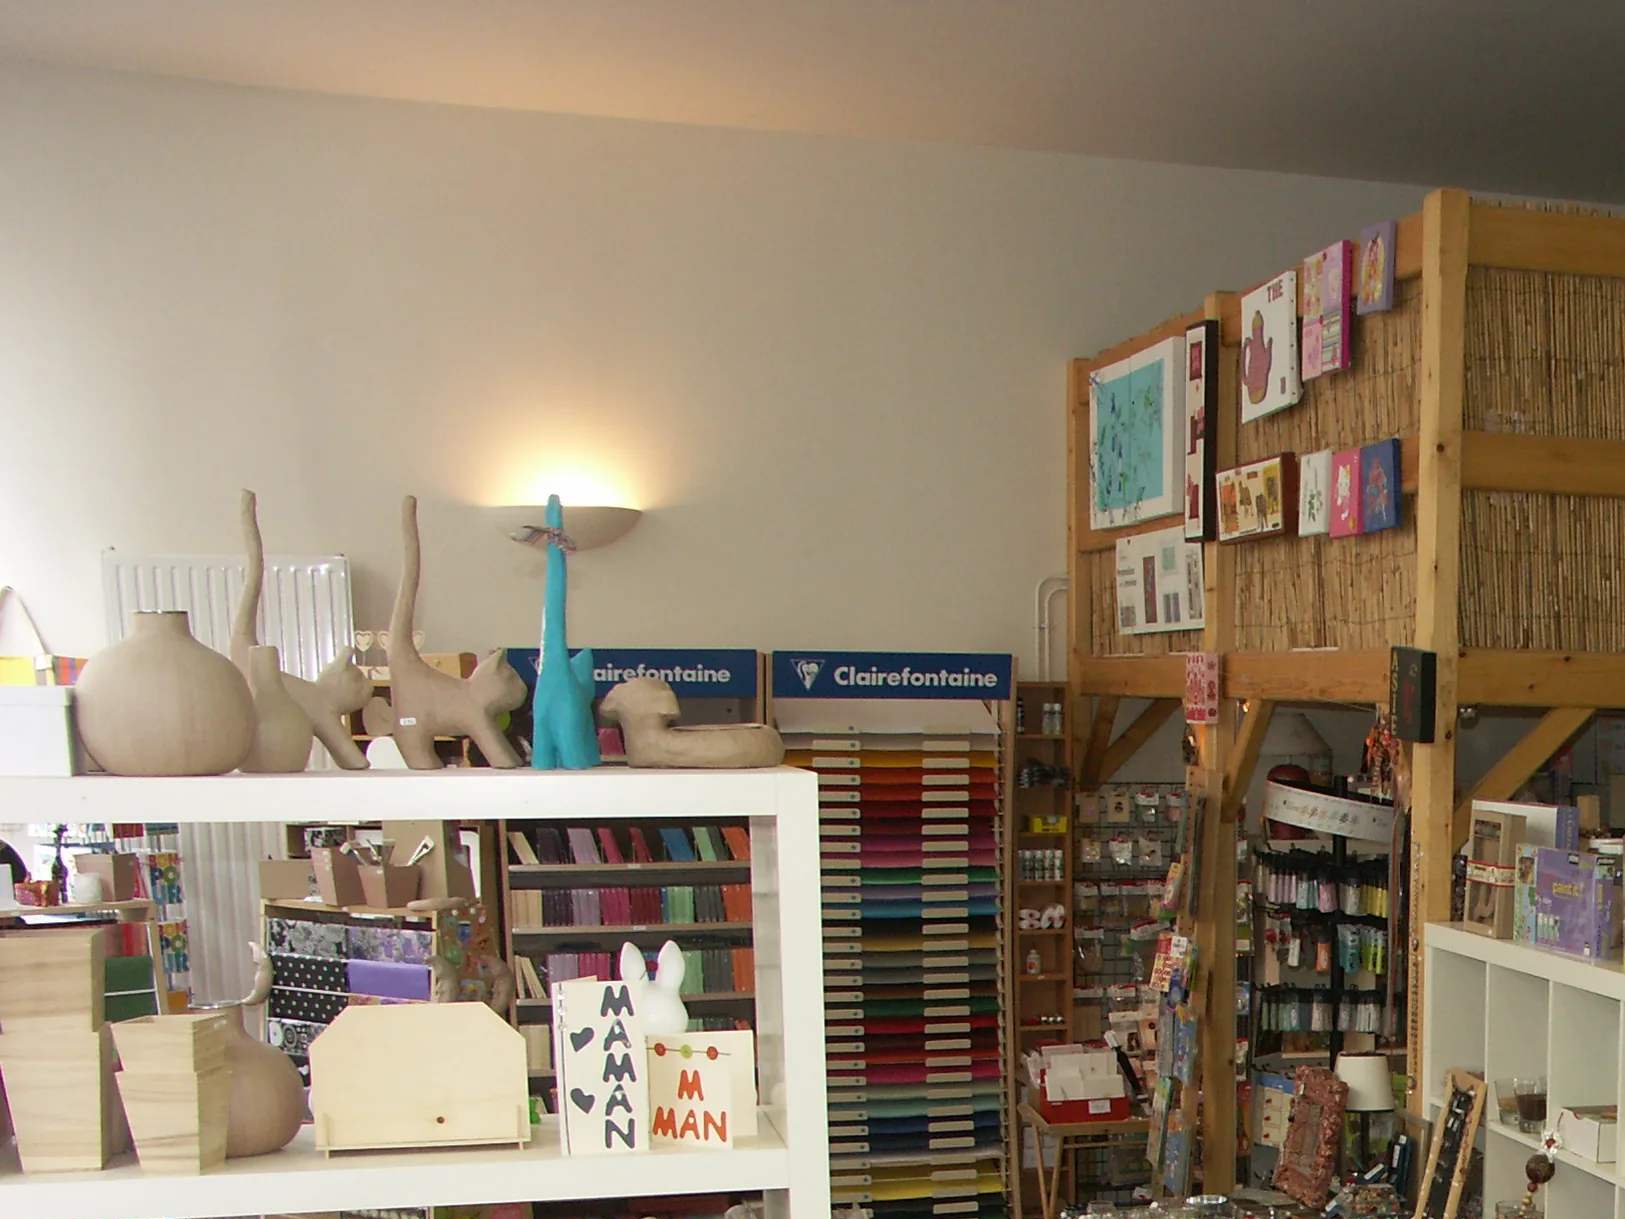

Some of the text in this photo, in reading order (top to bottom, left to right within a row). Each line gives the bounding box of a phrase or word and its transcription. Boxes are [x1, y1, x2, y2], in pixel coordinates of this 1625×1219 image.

[593, 663, 731, 683] airefontaine
[833, 666, 998, 688] Clairefontaine
[600, 985, 637, 1148] MAMAN
[652, 1106, 728, 1142] MAN
